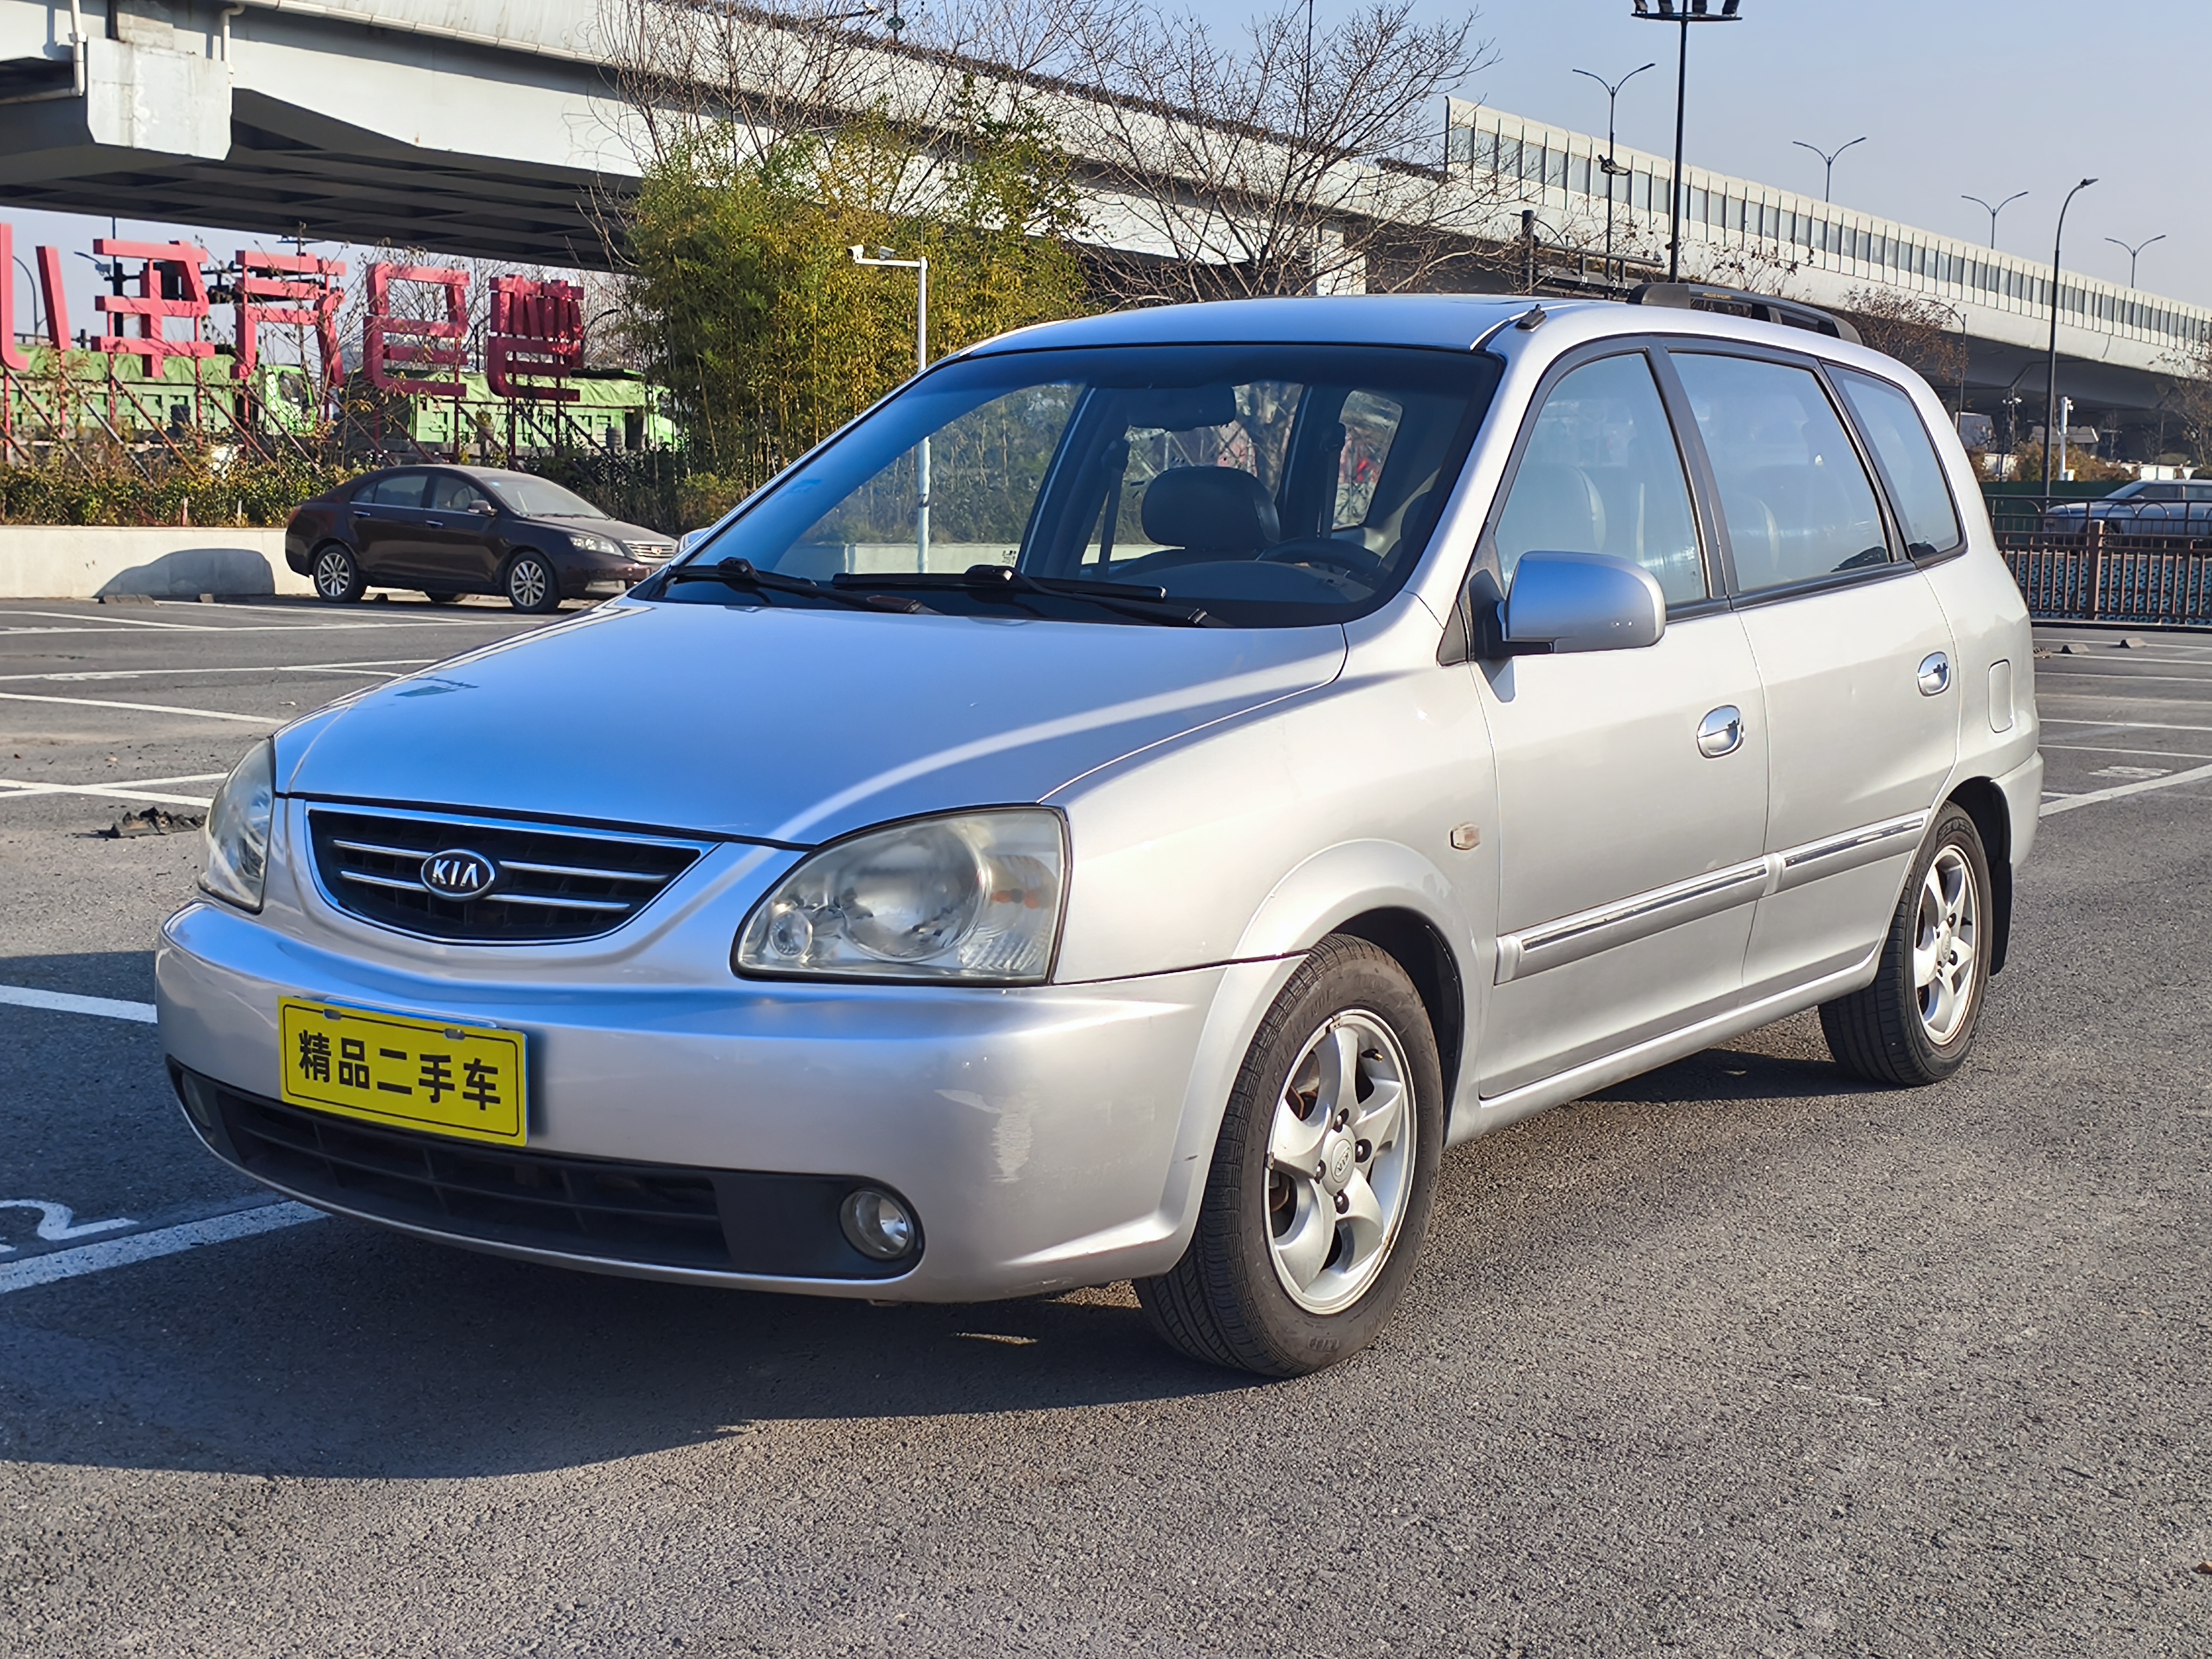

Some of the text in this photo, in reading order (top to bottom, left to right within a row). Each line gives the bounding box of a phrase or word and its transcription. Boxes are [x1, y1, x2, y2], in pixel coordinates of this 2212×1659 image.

[432, 859, 478, 888] KIA
[299, 1030, 501, 1110] 精品二手车
